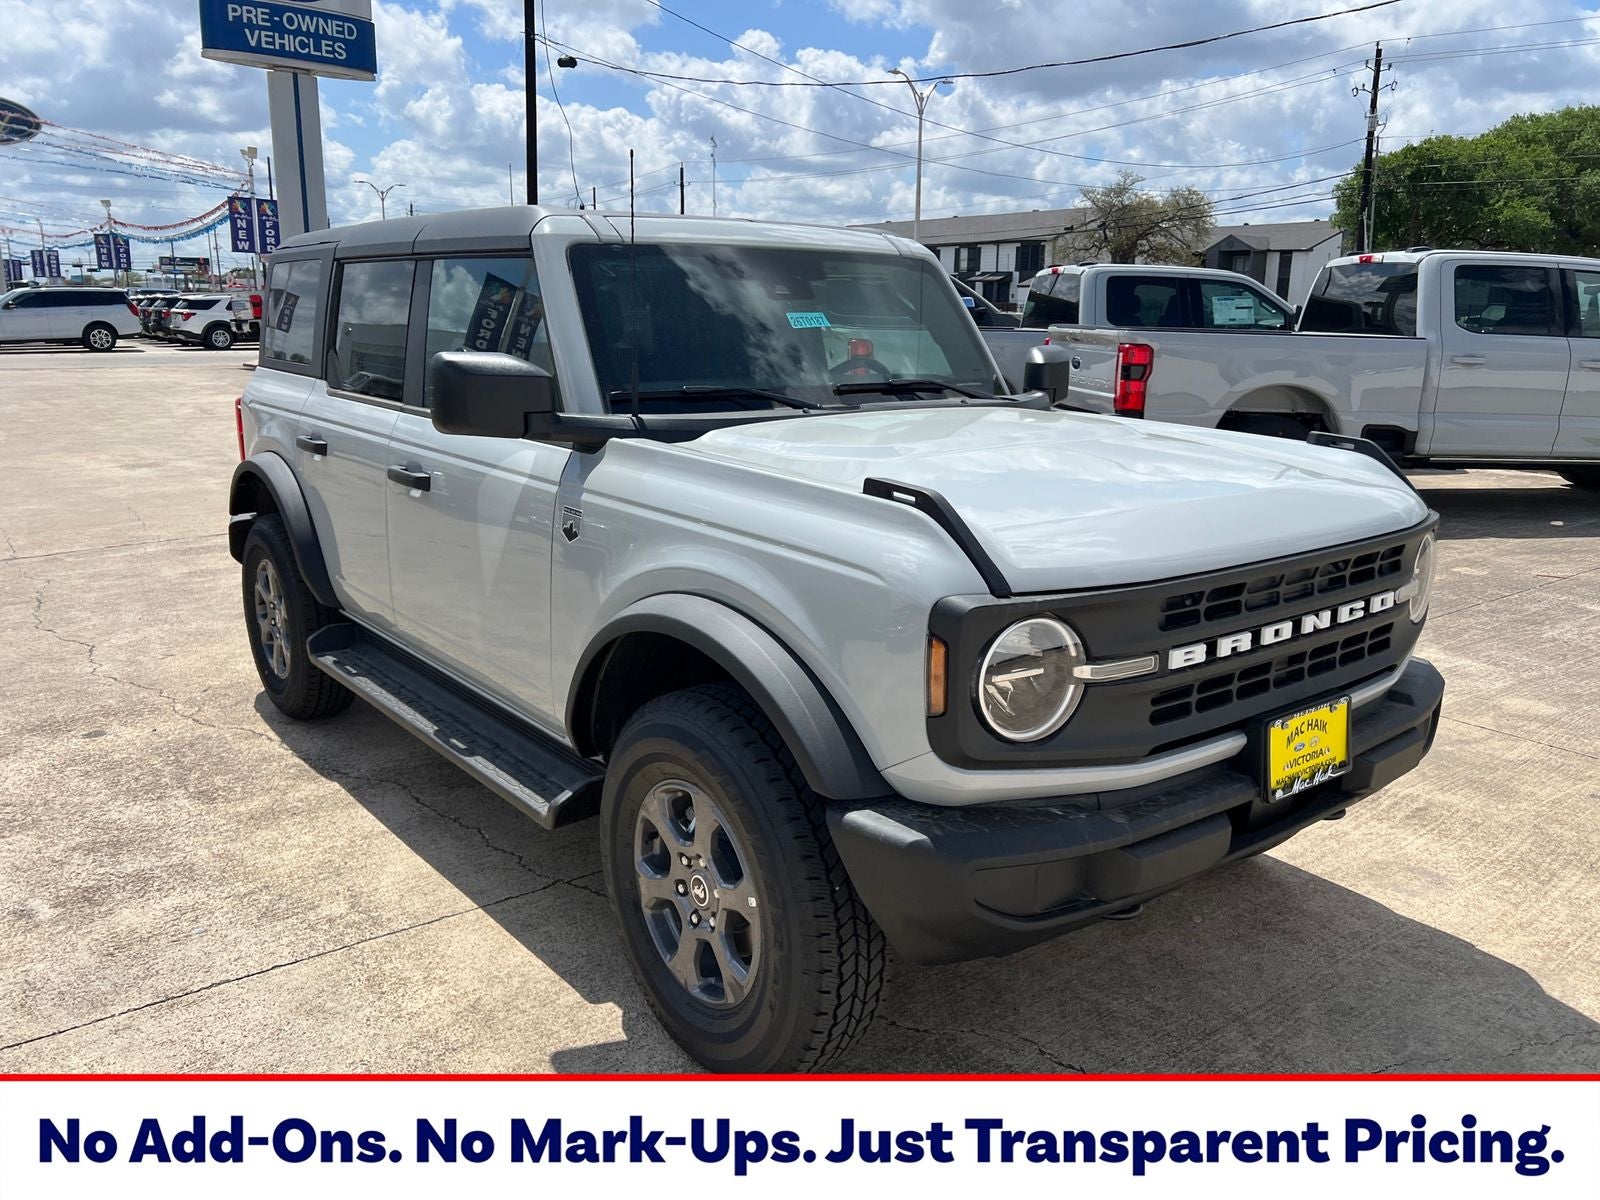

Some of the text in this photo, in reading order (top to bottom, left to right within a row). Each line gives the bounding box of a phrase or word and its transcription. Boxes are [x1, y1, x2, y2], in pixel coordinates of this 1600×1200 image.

[227, 4, 357, 40] PRE-OWNED
[244, 28, 347, 60] VEHICLES
[236, 218, 250, 251] NEW
[265, 220, 276, 252] FORD
[100, 247, 110, 268] NEW
[789, 315, 826, 327] 26T0187
[1168, 590, 1395, 670] BRONCO
[1286, 721, 1305, 749] MAC
[1306, 718, 1328, 734] HAIK
[1288, 747, 1325, 769] VICTORIA
[1291, 777, 1313, 794] Mac
